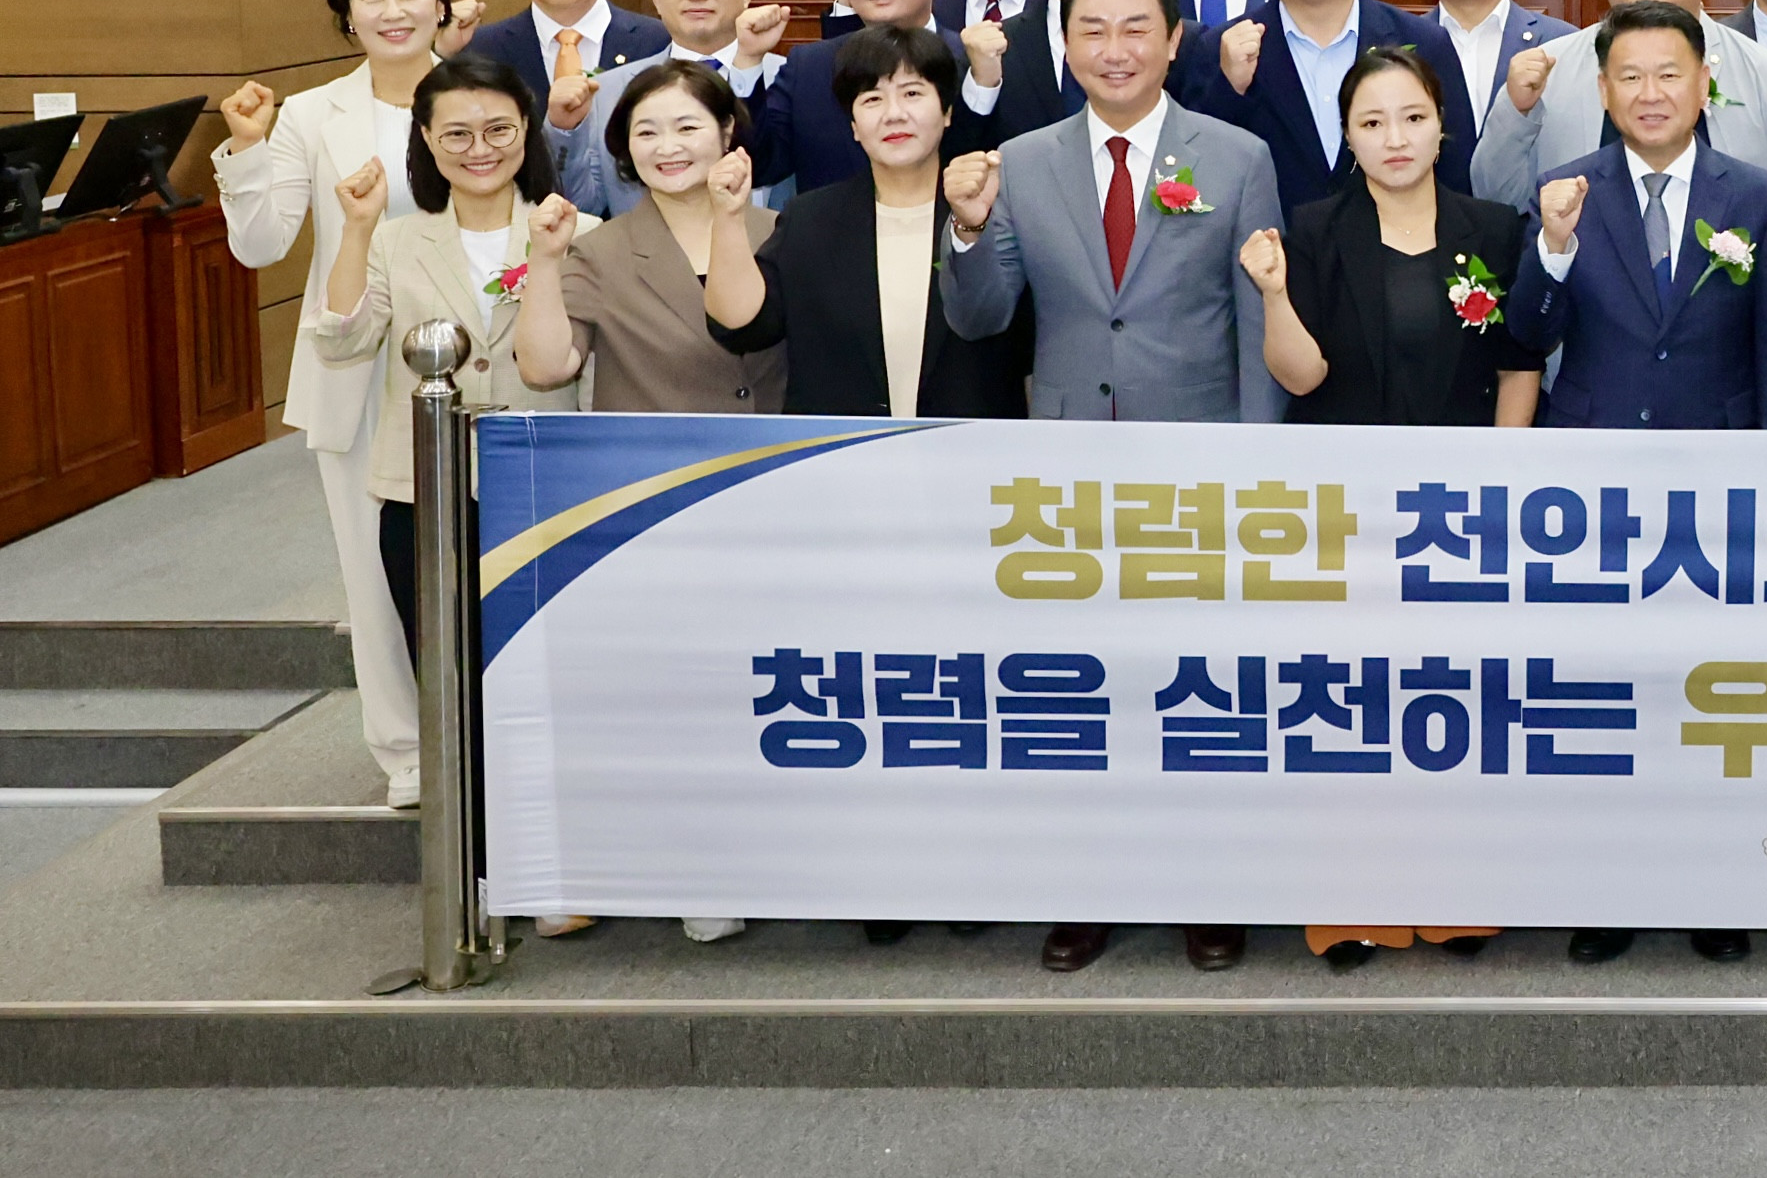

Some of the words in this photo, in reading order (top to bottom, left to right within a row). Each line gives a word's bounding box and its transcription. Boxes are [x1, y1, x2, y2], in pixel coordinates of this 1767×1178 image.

[990, 477, 1357, 601] 청렴한
[752, 648, 1111, 771] 청렴을
[1155, 654, 1637, 776] 실천하는
